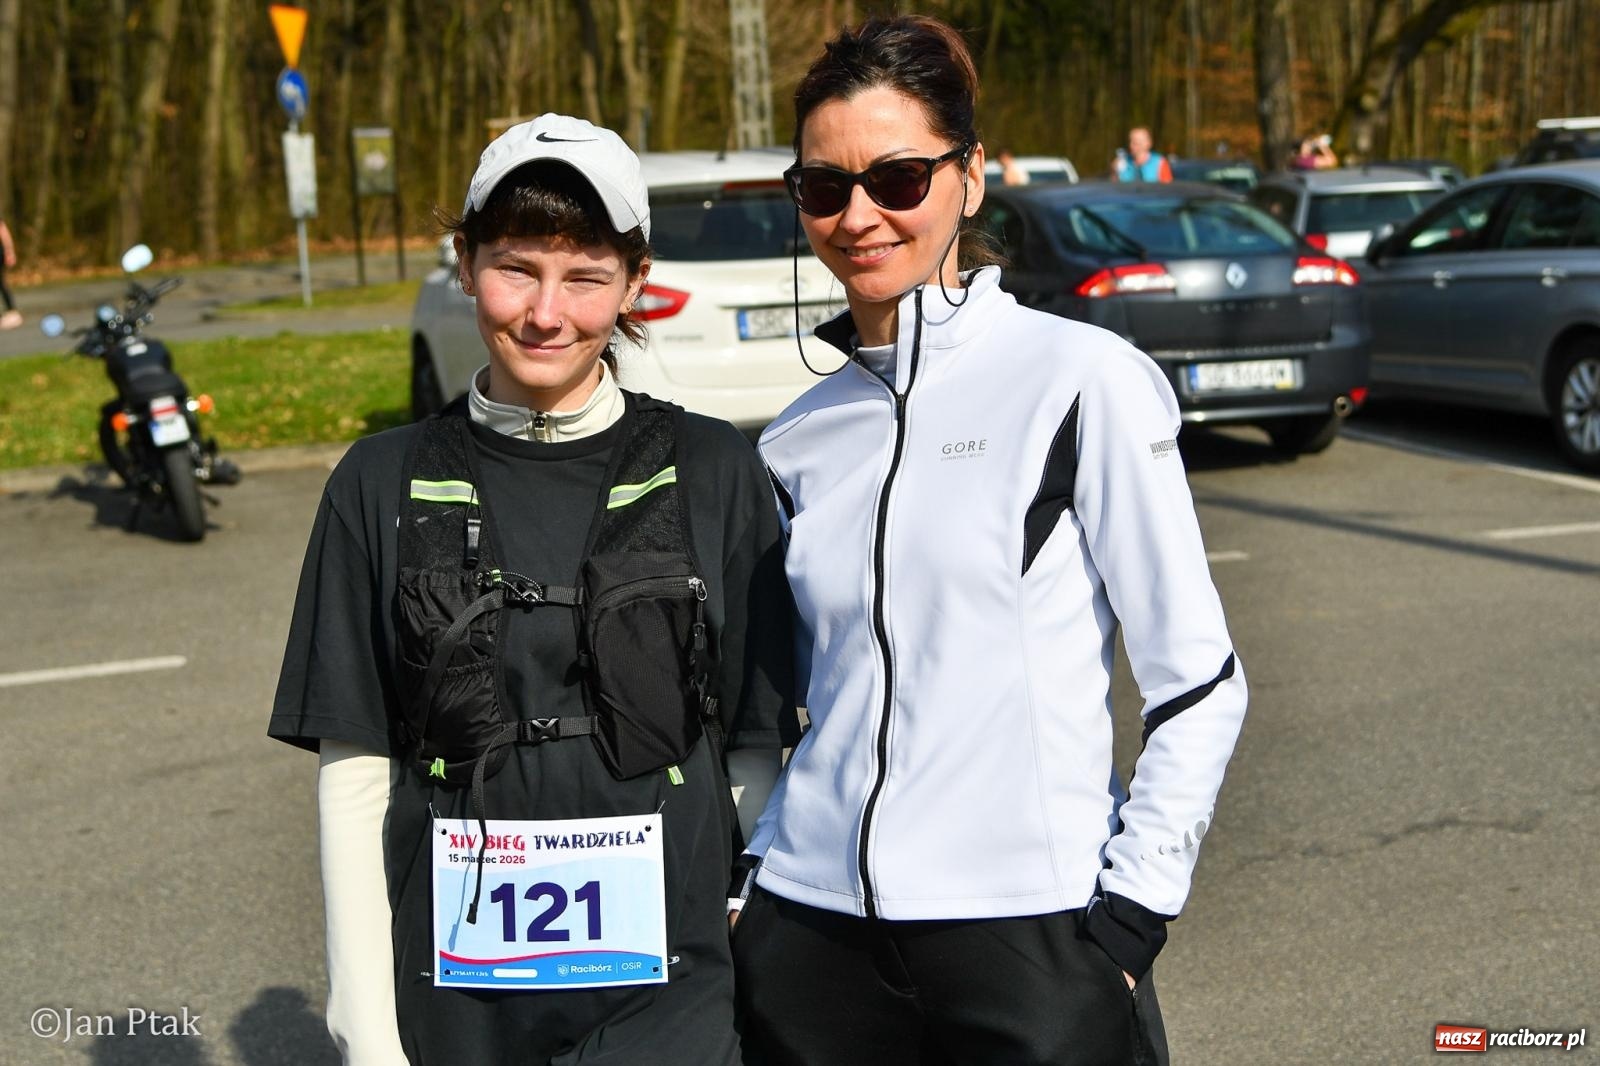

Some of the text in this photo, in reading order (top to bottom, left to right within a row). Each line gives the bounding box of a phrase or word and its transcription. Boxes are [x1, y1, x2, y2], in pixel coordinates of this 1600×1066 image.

[942, 439, 988, 455] GORE
[449, 830, 646, 850] XIV BIEG TWARDZIELA
[448, 854, 459, 863] 15
[499, 855, 526, 864] 2026
[490, 880, 602, 942] 121
[570, 963, 612, 974] Racibórz
